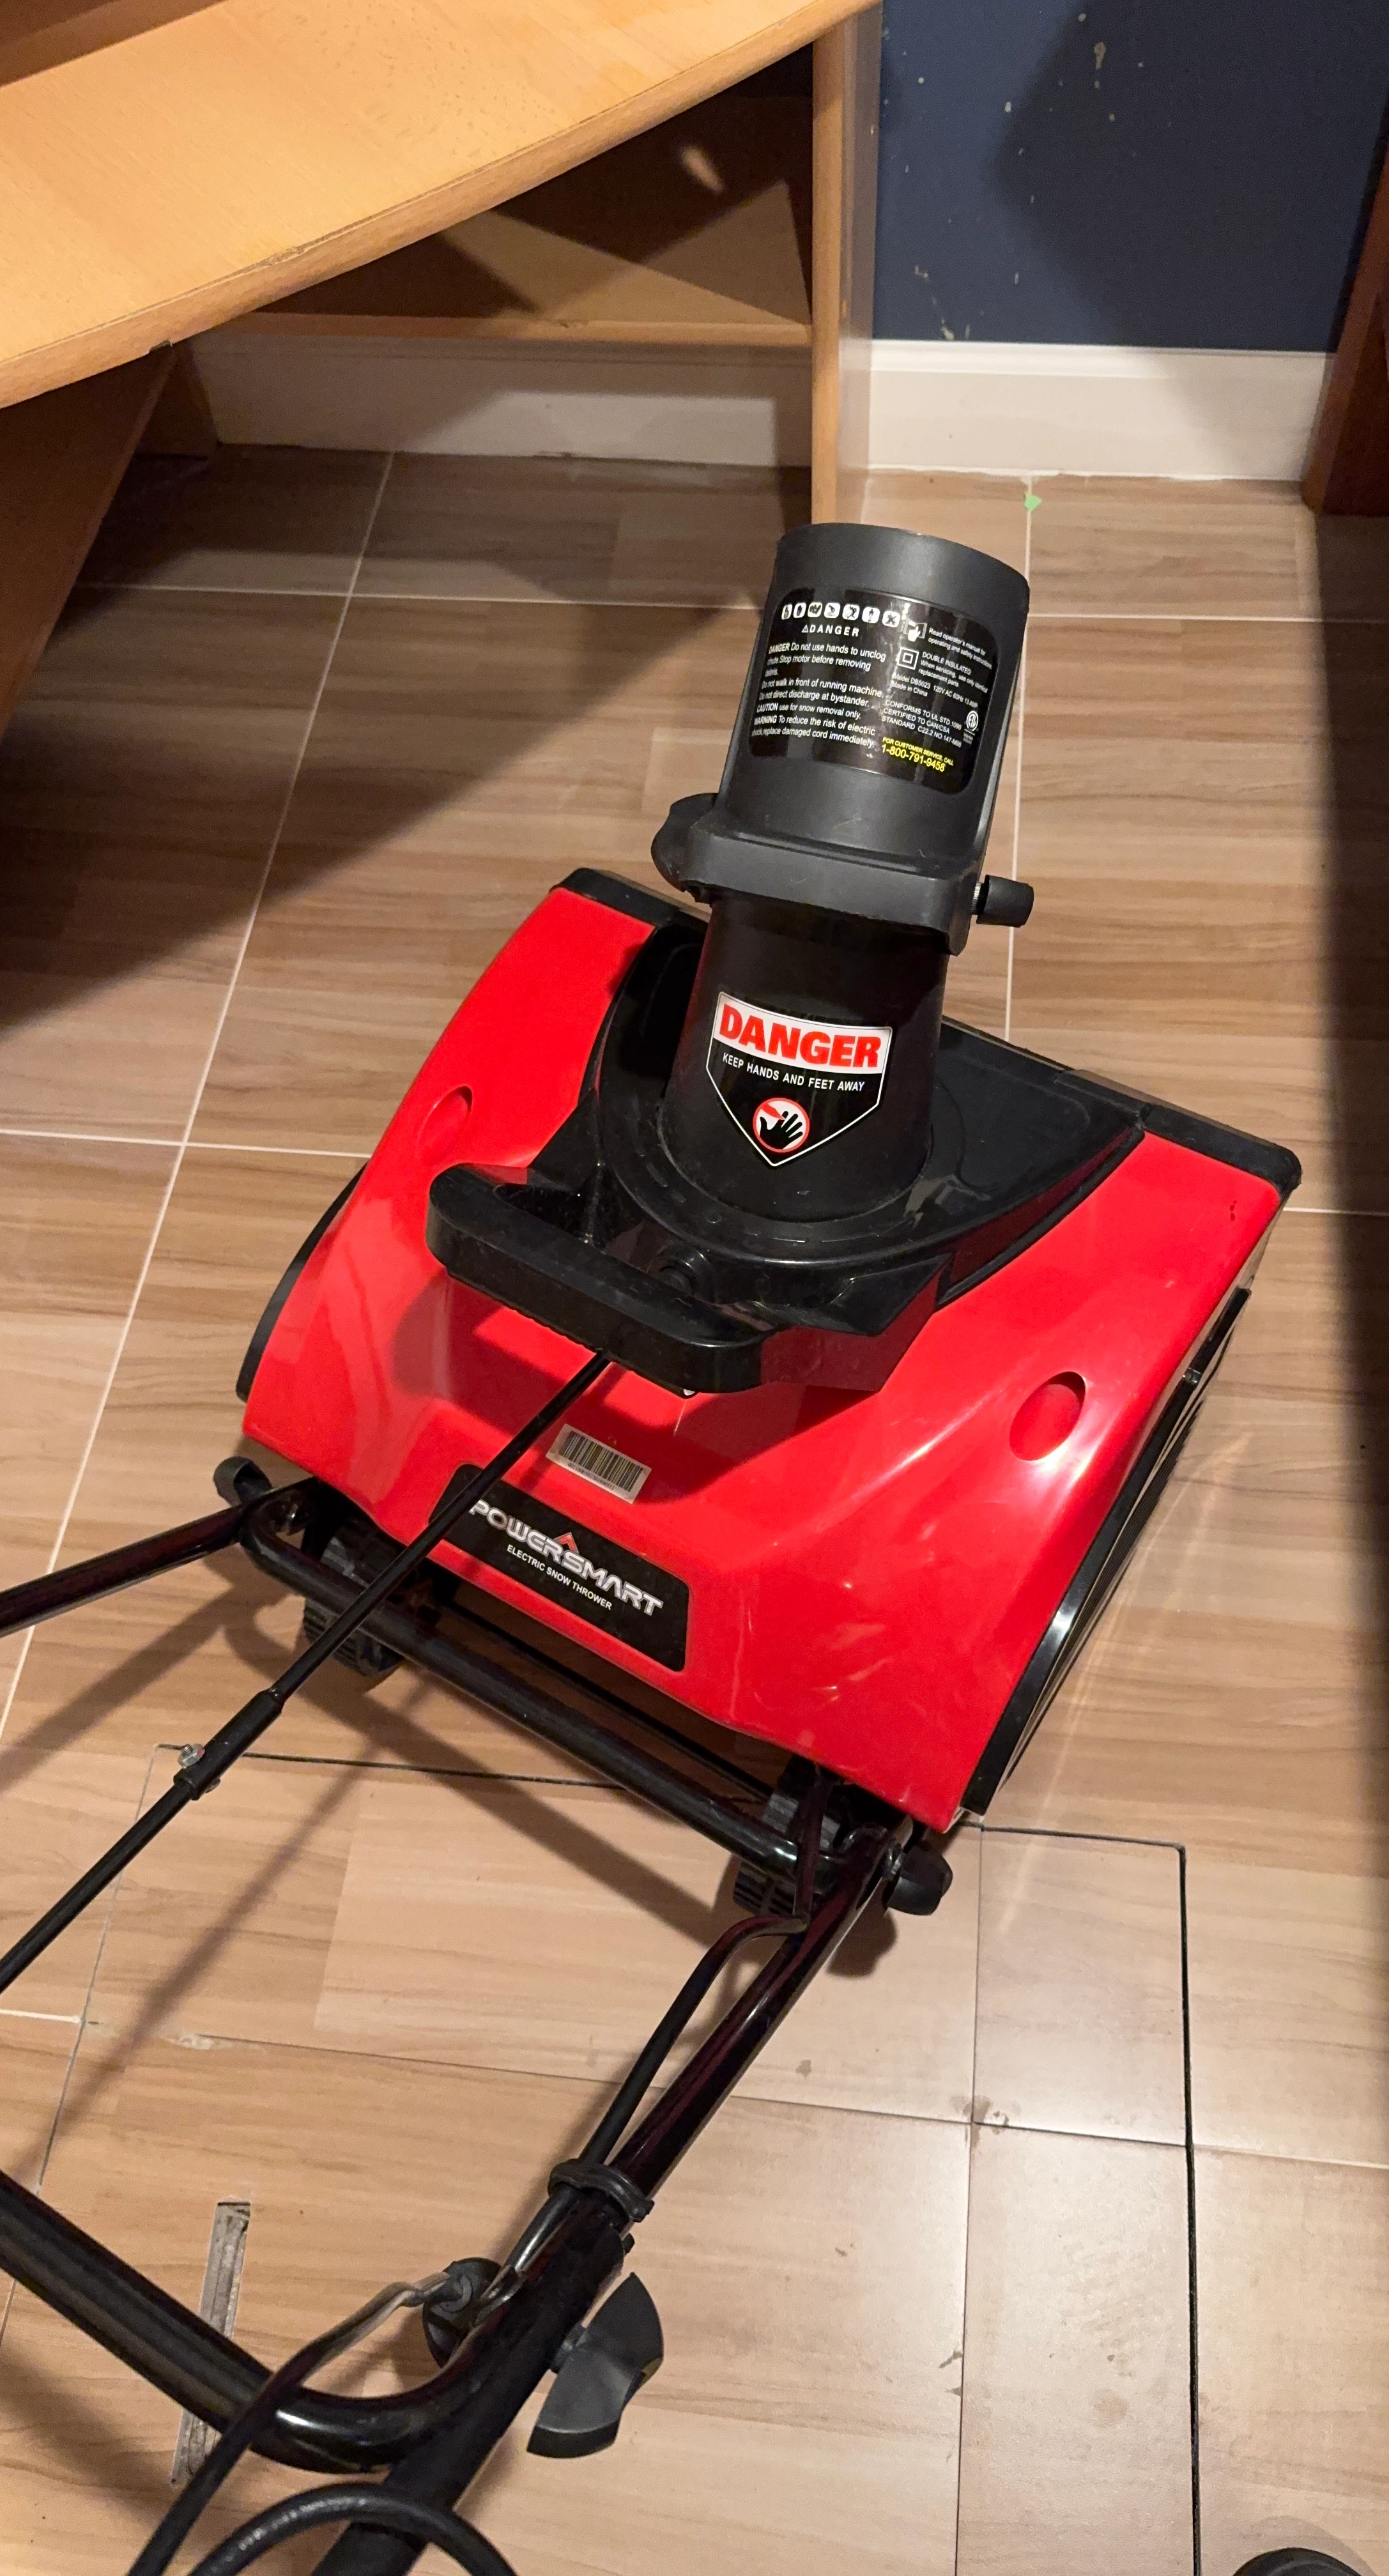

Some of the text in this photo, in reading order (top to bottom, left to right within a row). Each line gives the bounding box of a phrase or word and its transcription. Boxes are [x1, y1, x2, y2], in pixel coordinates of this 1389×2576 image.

[810, 625, 859, 636] DANGER
[929, 628, 942, 637] Read
[769, 643, 790, 654] DANGER
[791, 642, 799, 650] Do
[826, 644, 848, 654] hands
[860, 648, 886, 662] unclog
[928, 638, 951, 650] operating
[779, 655, 791, 664] Stop
[811, 655, 834, 664] before
[835, 657, 871, 671] removing
[921, 660, 935, 669] When
[922, 652, 944, 664] DOUBLE
[918, 668, 948, 683] replacement
[795, 678, 810, 687] front
[811, 678, 819, 687] of
[820, 680, 847, 693] running
[848, 684, 884, 698] machine.
[910, 678, 930, 689] DB5023
[933, 685, 945, 694] 120V
[913, 688, 928, 696] China
[773, 690, 788, 698] direct
[788, 689, 820, 701] discharge
[830, 693, 869, 707] bystander.
[756, 703, 779, 713] CAUTION
[817, 705, 844, 716] removal
[845, 710, 861, 719] only.
[885, 700, 921, 715] CONFORMS
[754, 715, 875, 735] WARNING To reduce the risk of electric
[882, 716, 915, 730] STANDARD
[917, 726, 933, 735] C22.2
[884, 709, 916, 721] CERTIFIED
[926, 721, 949, 734] CAN/CSA
[782, 727, 811, 737] damaged
[812, 730, 827, 739] cord
[829, 732, 875, 748] immediately.
[882, 744, 946, 772] 1-800-791-9458
[894, 740, 923, 753] CUSTOMER
[944, 756, 954, 766] CALL
[719, 1004, 882, 1068] DANGER
[723, 1052, 865, 1092] KEEP HANDS AND FEET AWAY
[468, 1499, 664, 1616] POWERSMART
[507, 1544, 612, 1611] ELECTRIC SNOW THROWER
